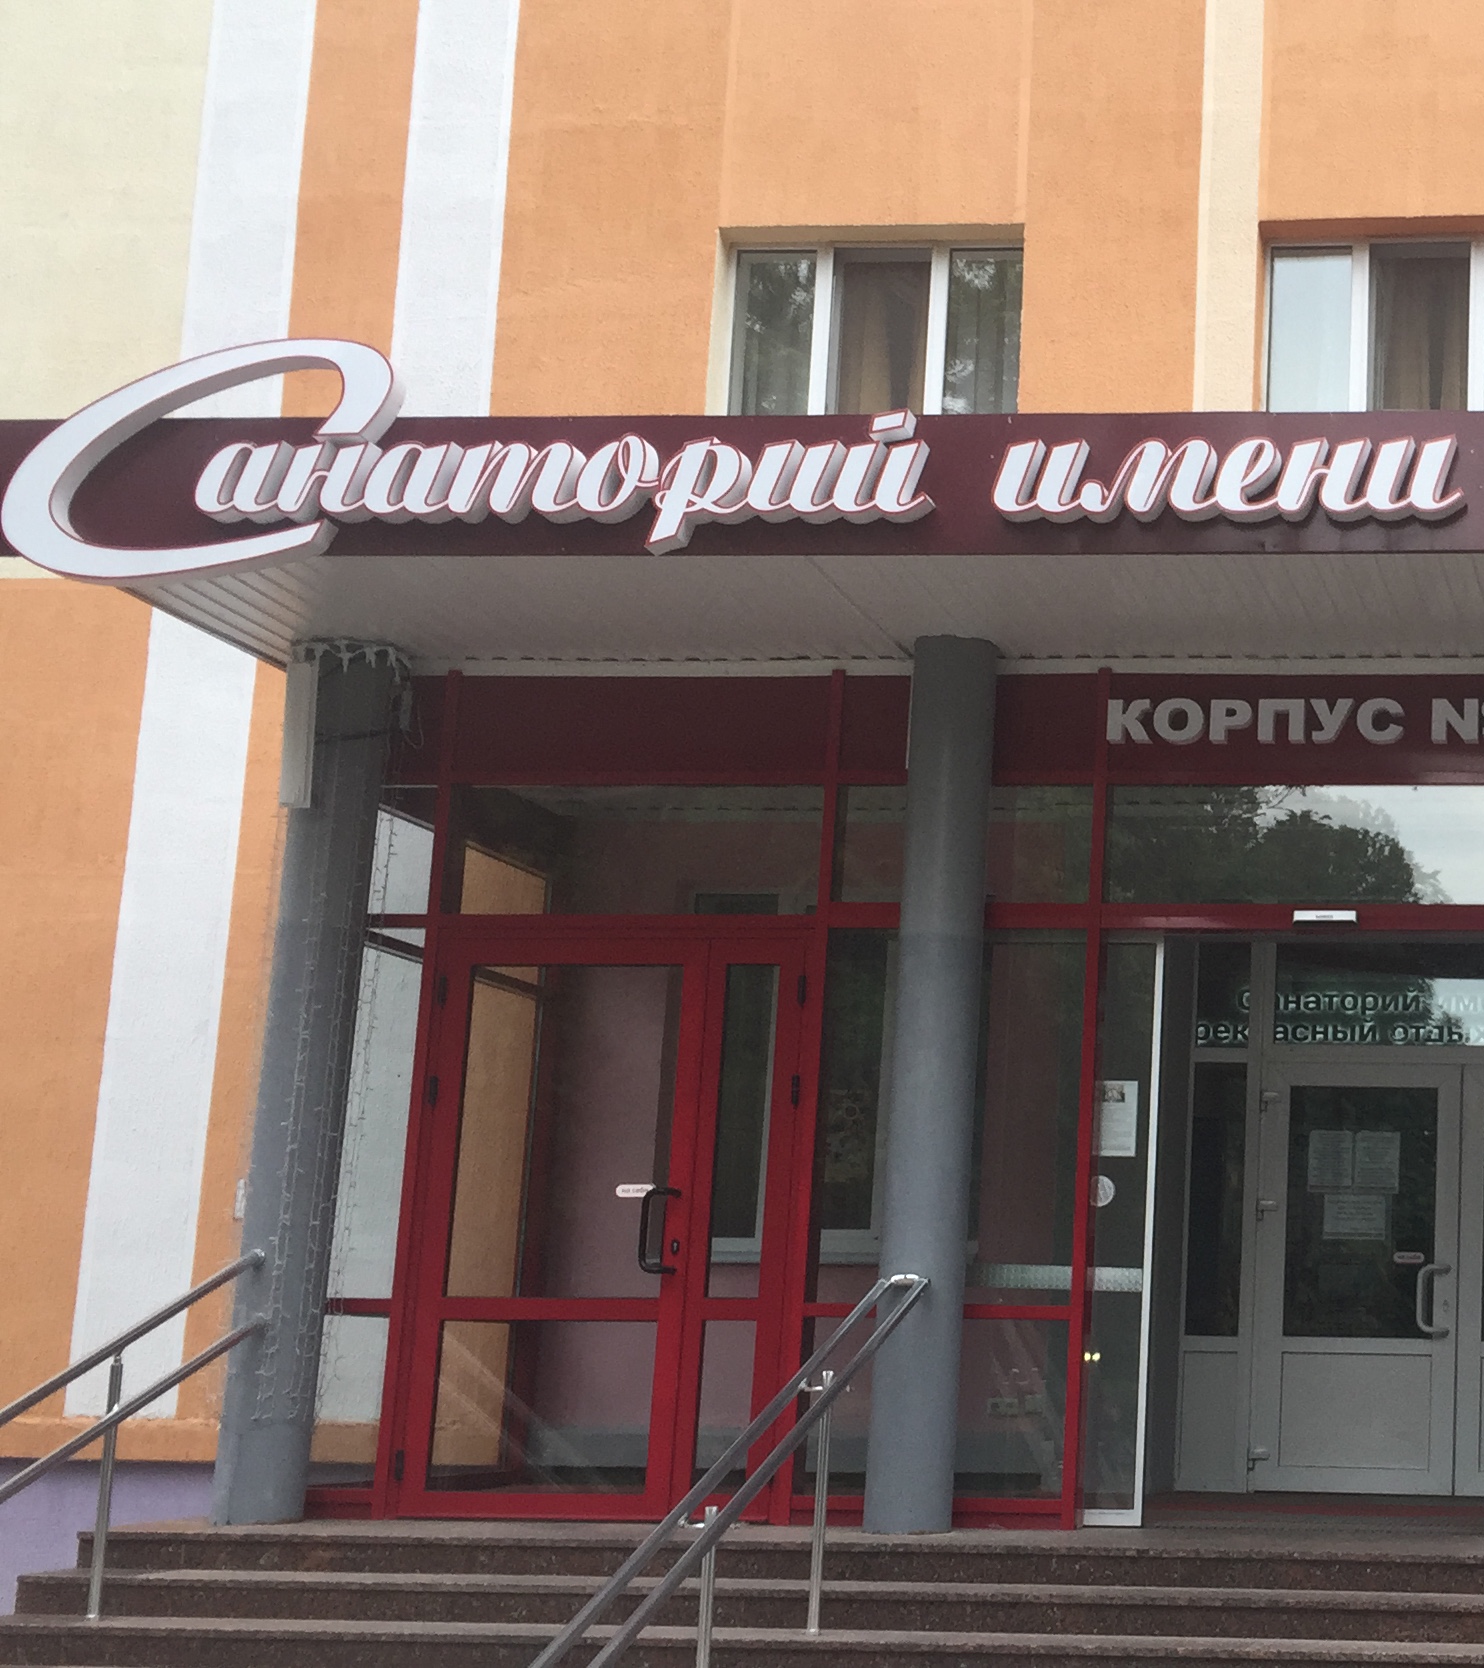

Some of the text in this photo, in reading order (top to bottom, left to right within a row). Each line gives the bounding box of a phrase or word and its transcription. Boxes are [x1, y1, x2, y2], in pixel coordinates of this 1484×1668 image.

[1, 338, 937, 579] Санаторий
[991, 434, 1466, 523] имени
[1105, 698, 1405, 745] КОРПУС
[1237, 987, 1421, 1016] Снаторий
